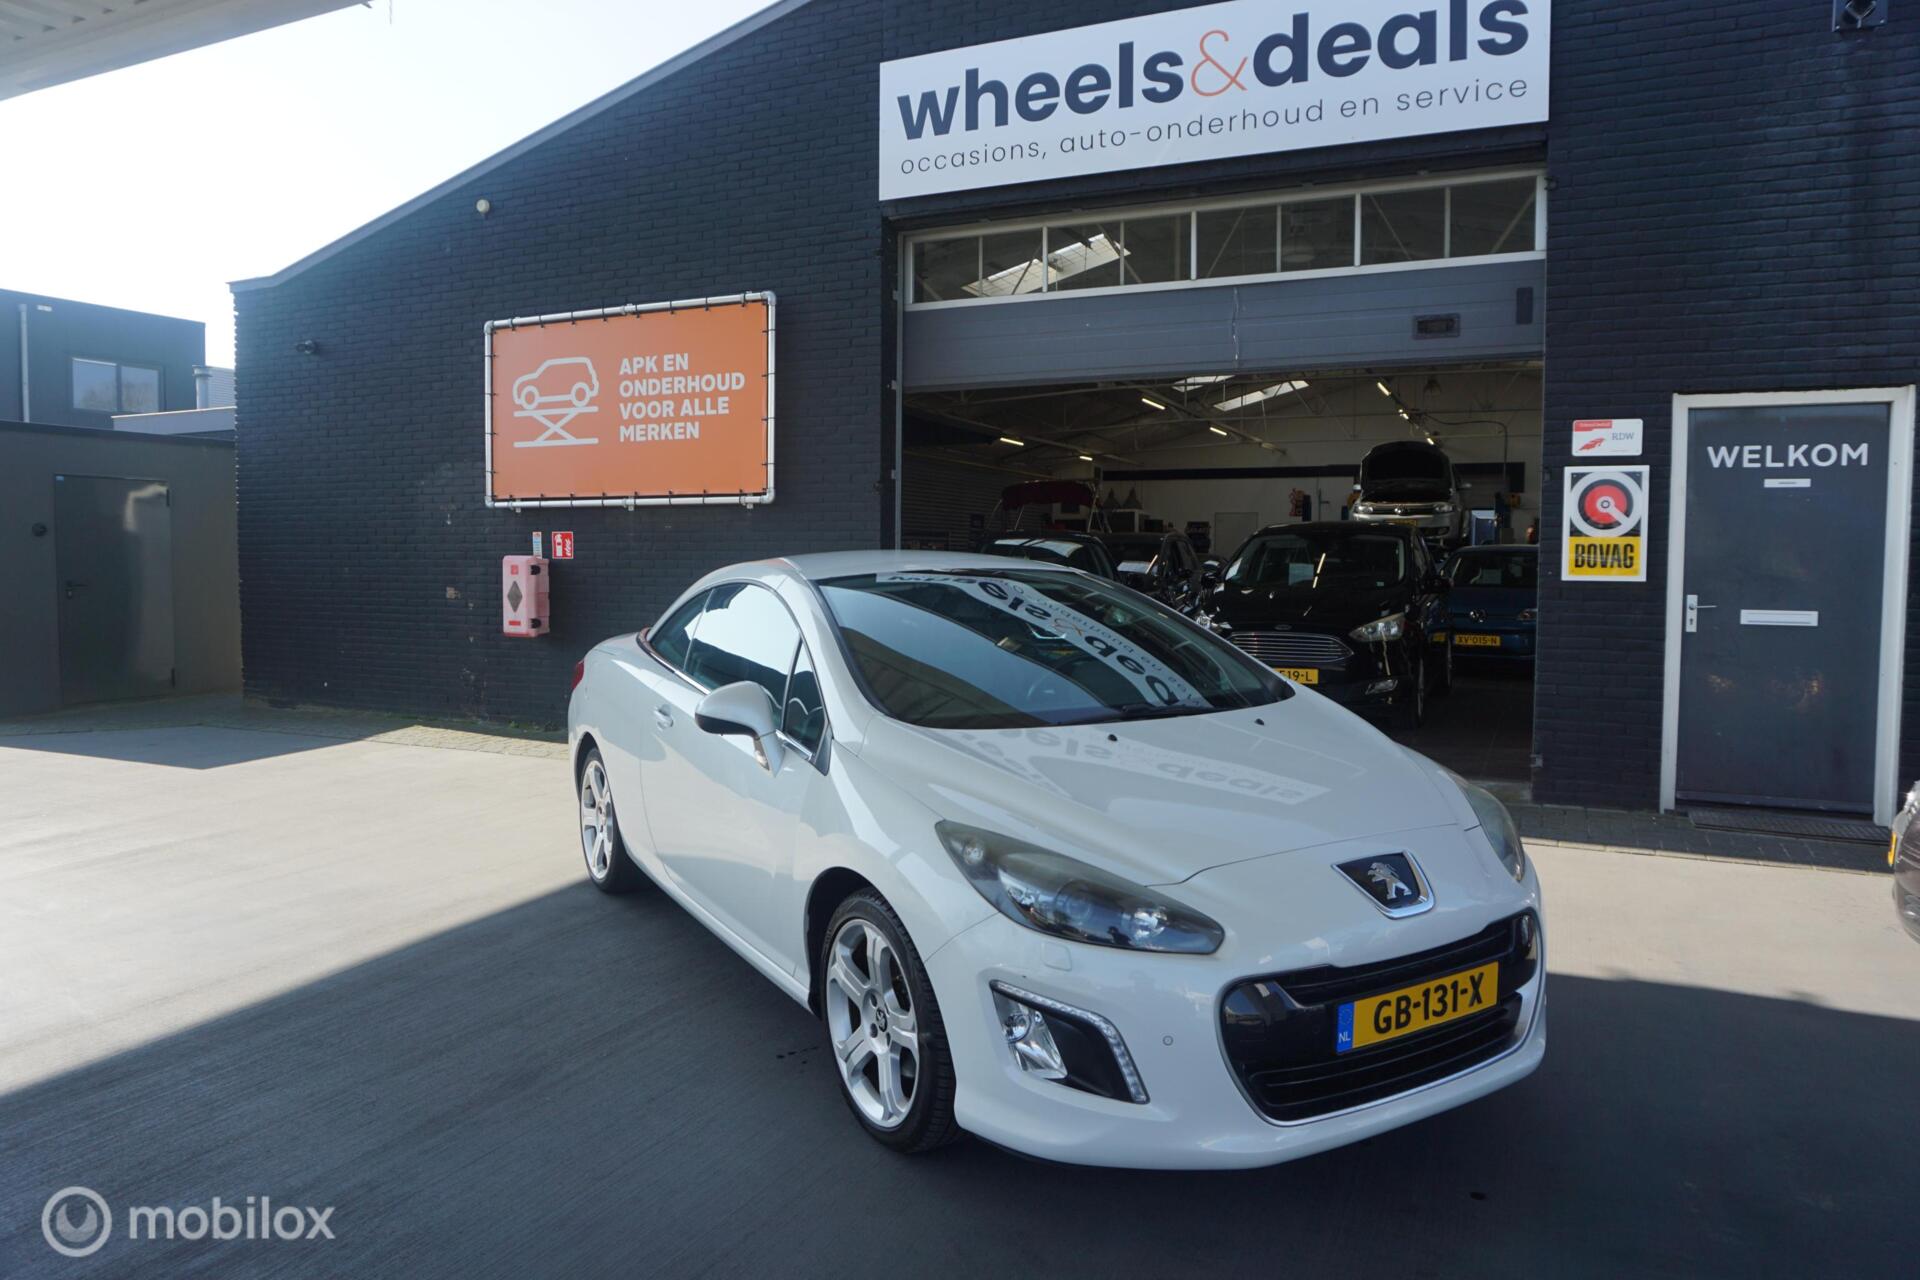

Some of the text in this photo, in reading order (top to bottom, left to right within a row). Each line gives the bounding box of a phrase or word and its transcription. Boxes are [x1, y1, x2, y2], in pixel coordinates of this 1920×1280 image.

[897, 0, 1529, 140] wheels&deals
[900, 76, 1529, 175] occasions, auto-onderhoud en service
[619, 353, 690, 375] APK EN
[619, 372, 746, 398] ONDERHOUD
[619, 396, 730, 420] VOOR ALLE
[619, 421, 700, 442] MERKEN
[1611, 432, 1635, 440] RDW
[1706, 443, 1869, 468] WELKOM
[1574, 543, 1635, 569] BOVAG
[1373, 972, 1485, 1034] GB-131-X
[1338, 1031, 1351, 1043] NL
